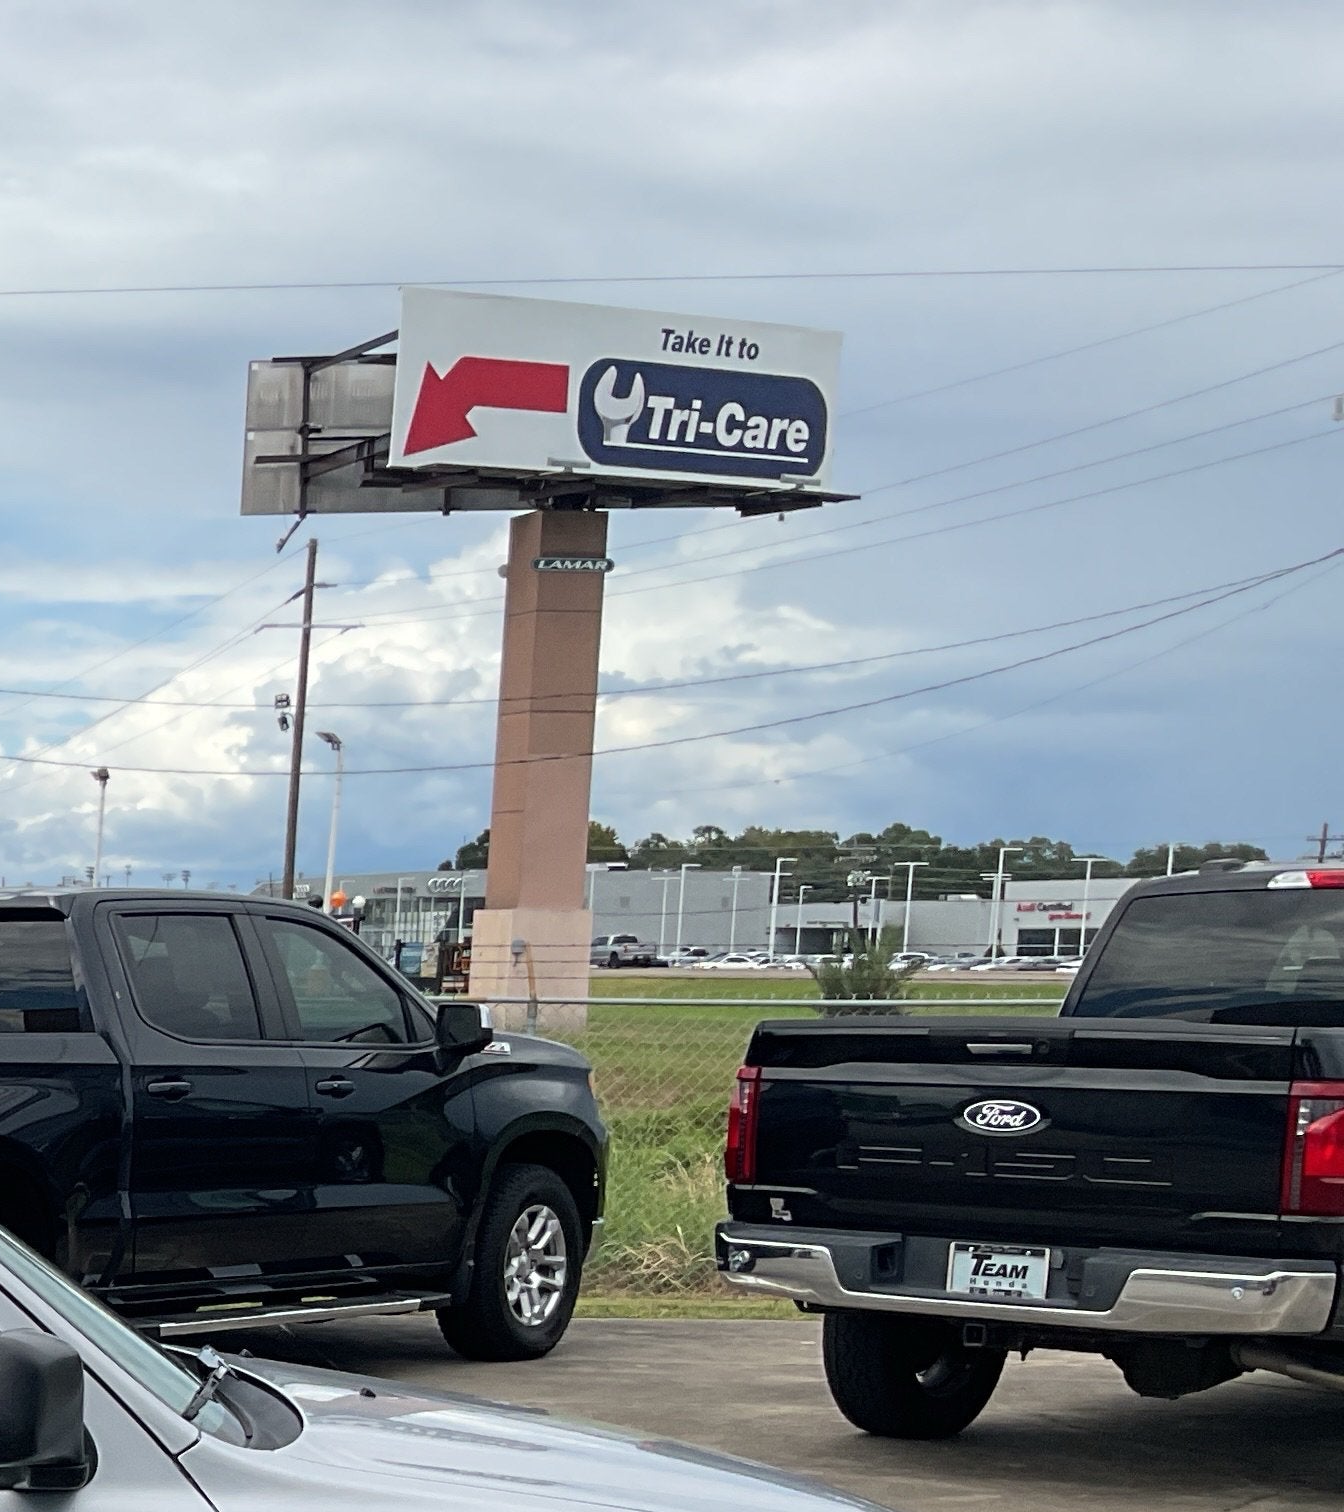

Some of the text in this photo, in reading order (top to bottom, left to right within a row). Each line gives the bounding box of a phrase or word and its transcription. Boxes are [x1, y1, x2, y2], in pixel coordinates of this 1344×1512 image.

[661, 328, 760, 360] Take It to
[647, 395, 810, 453] Tri-Care
[537, 560, 608, 570] LAMAR
[976, 1104, 1027, 1126] Ford
[970, 1253, 1029, 1279] TEAM
[969, 1278, 1027, 1288] Honda
